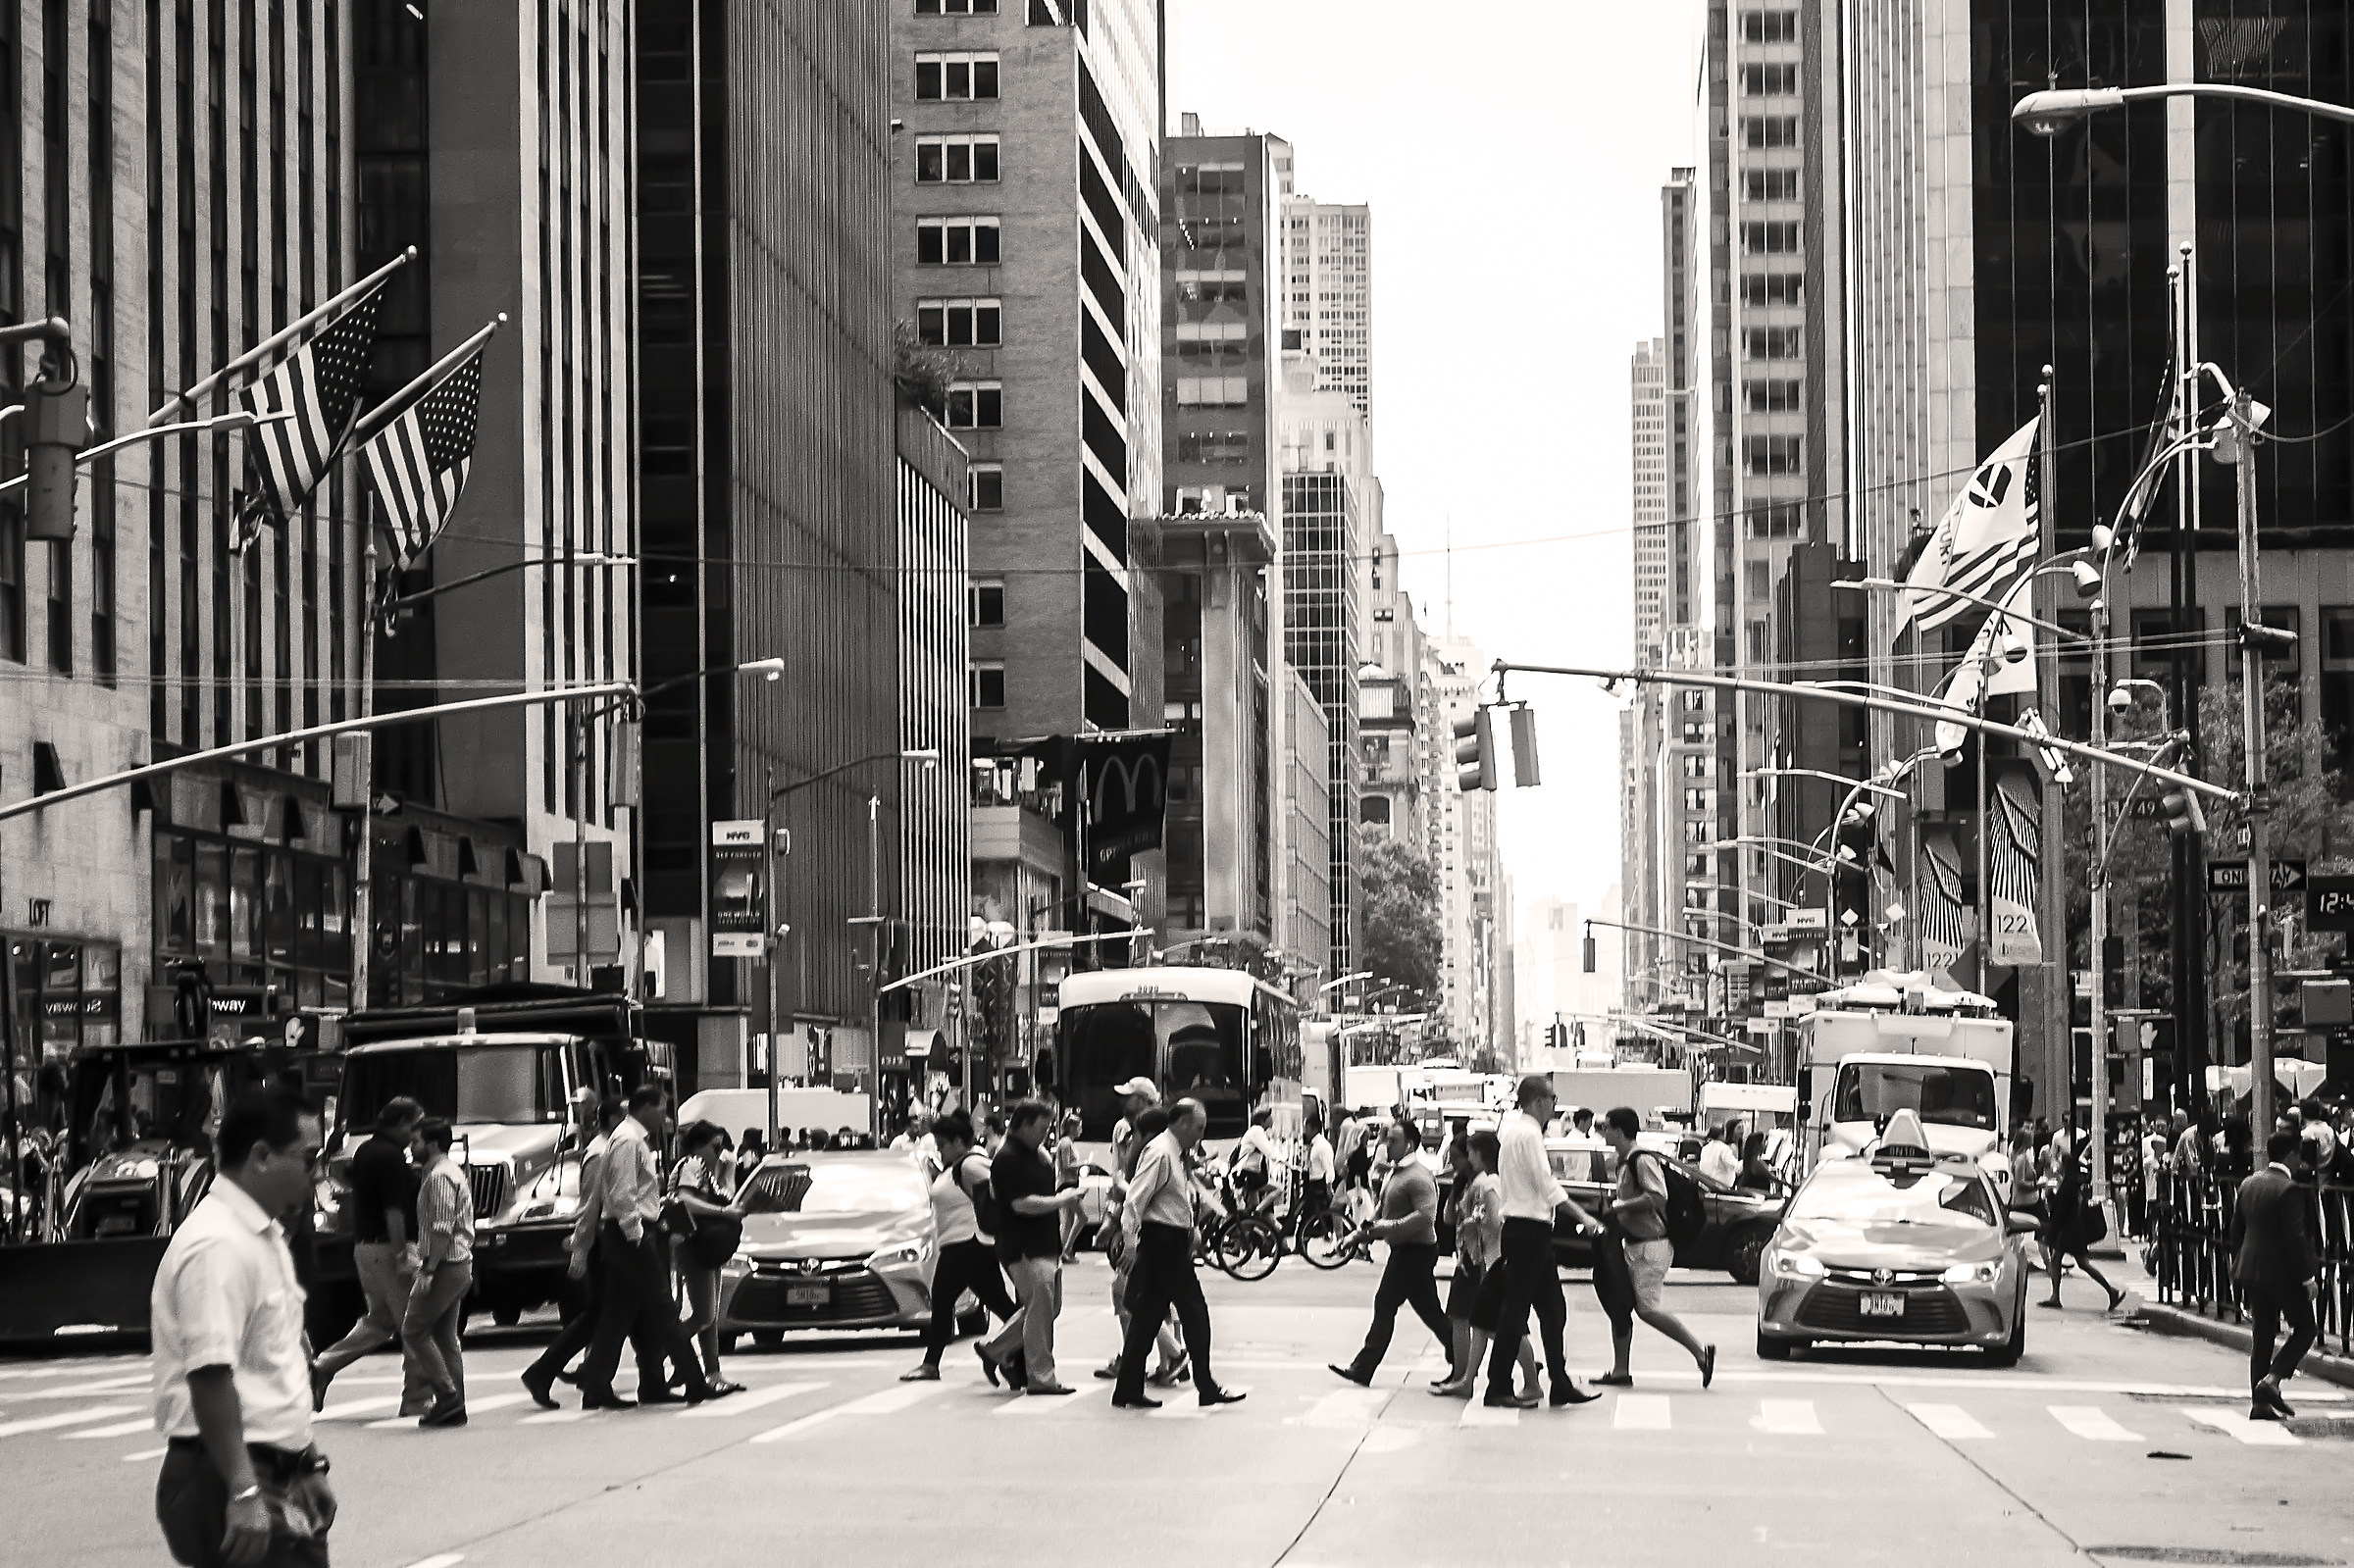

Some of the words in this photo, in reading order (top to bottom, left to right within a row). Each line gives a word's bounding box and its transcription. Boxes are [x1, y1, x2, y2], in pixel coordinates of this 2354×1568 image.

[2222, 869, 2245, 884] ON
[2269, 868, 2292, 885] AY
[29, 897, 51, 927] LOFT
